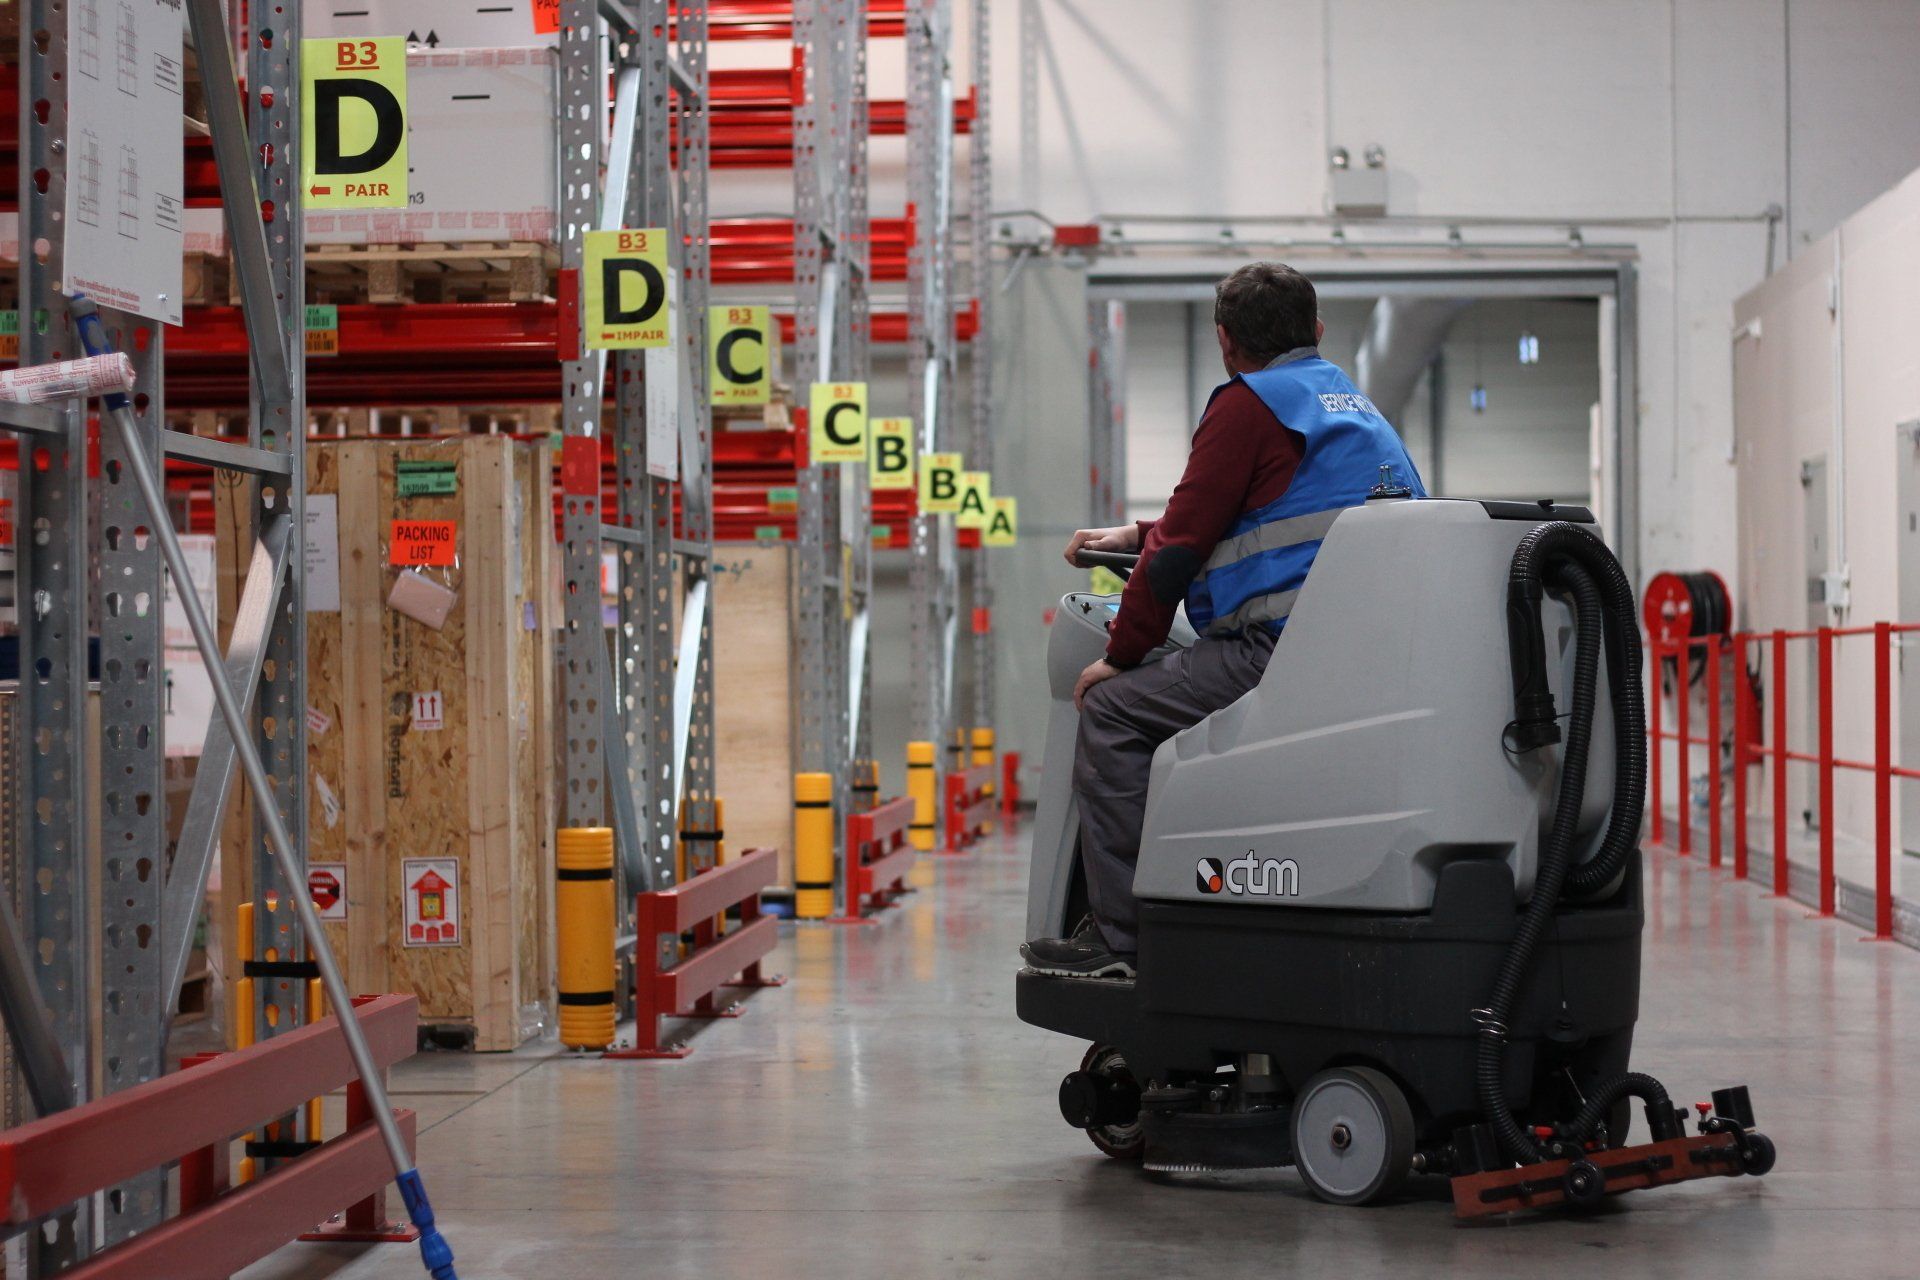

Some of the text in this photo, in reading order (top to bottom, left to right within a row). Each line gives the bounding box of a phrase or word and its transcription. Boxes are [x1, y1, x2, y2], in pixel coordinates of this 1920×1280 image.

[337, 41, 378, 66] B3
[314, 78, 404, 175] D
[345, 184, 389, 197] PAIR
[618, 232, 647, 250] B3
[602, 258, 665, 325] D
[729, 307, 752, 322] B3
[616, 330, 664, 341] IMPAIR
[716, 328, 763, 384] C
[1317, 393, 1359, 413] SERVICE
[824, 402, 861, 446] C
[877, 436, 908, 472] B
[931, 469, 957, 500] B
[960, 487, 985, 515] A
[397, 526, 450, 542] PACKING
[990, 511, 1012, 535] A
[410, 545, 435, 560] LIST
[1226, 849, 1299, 896] ctm
